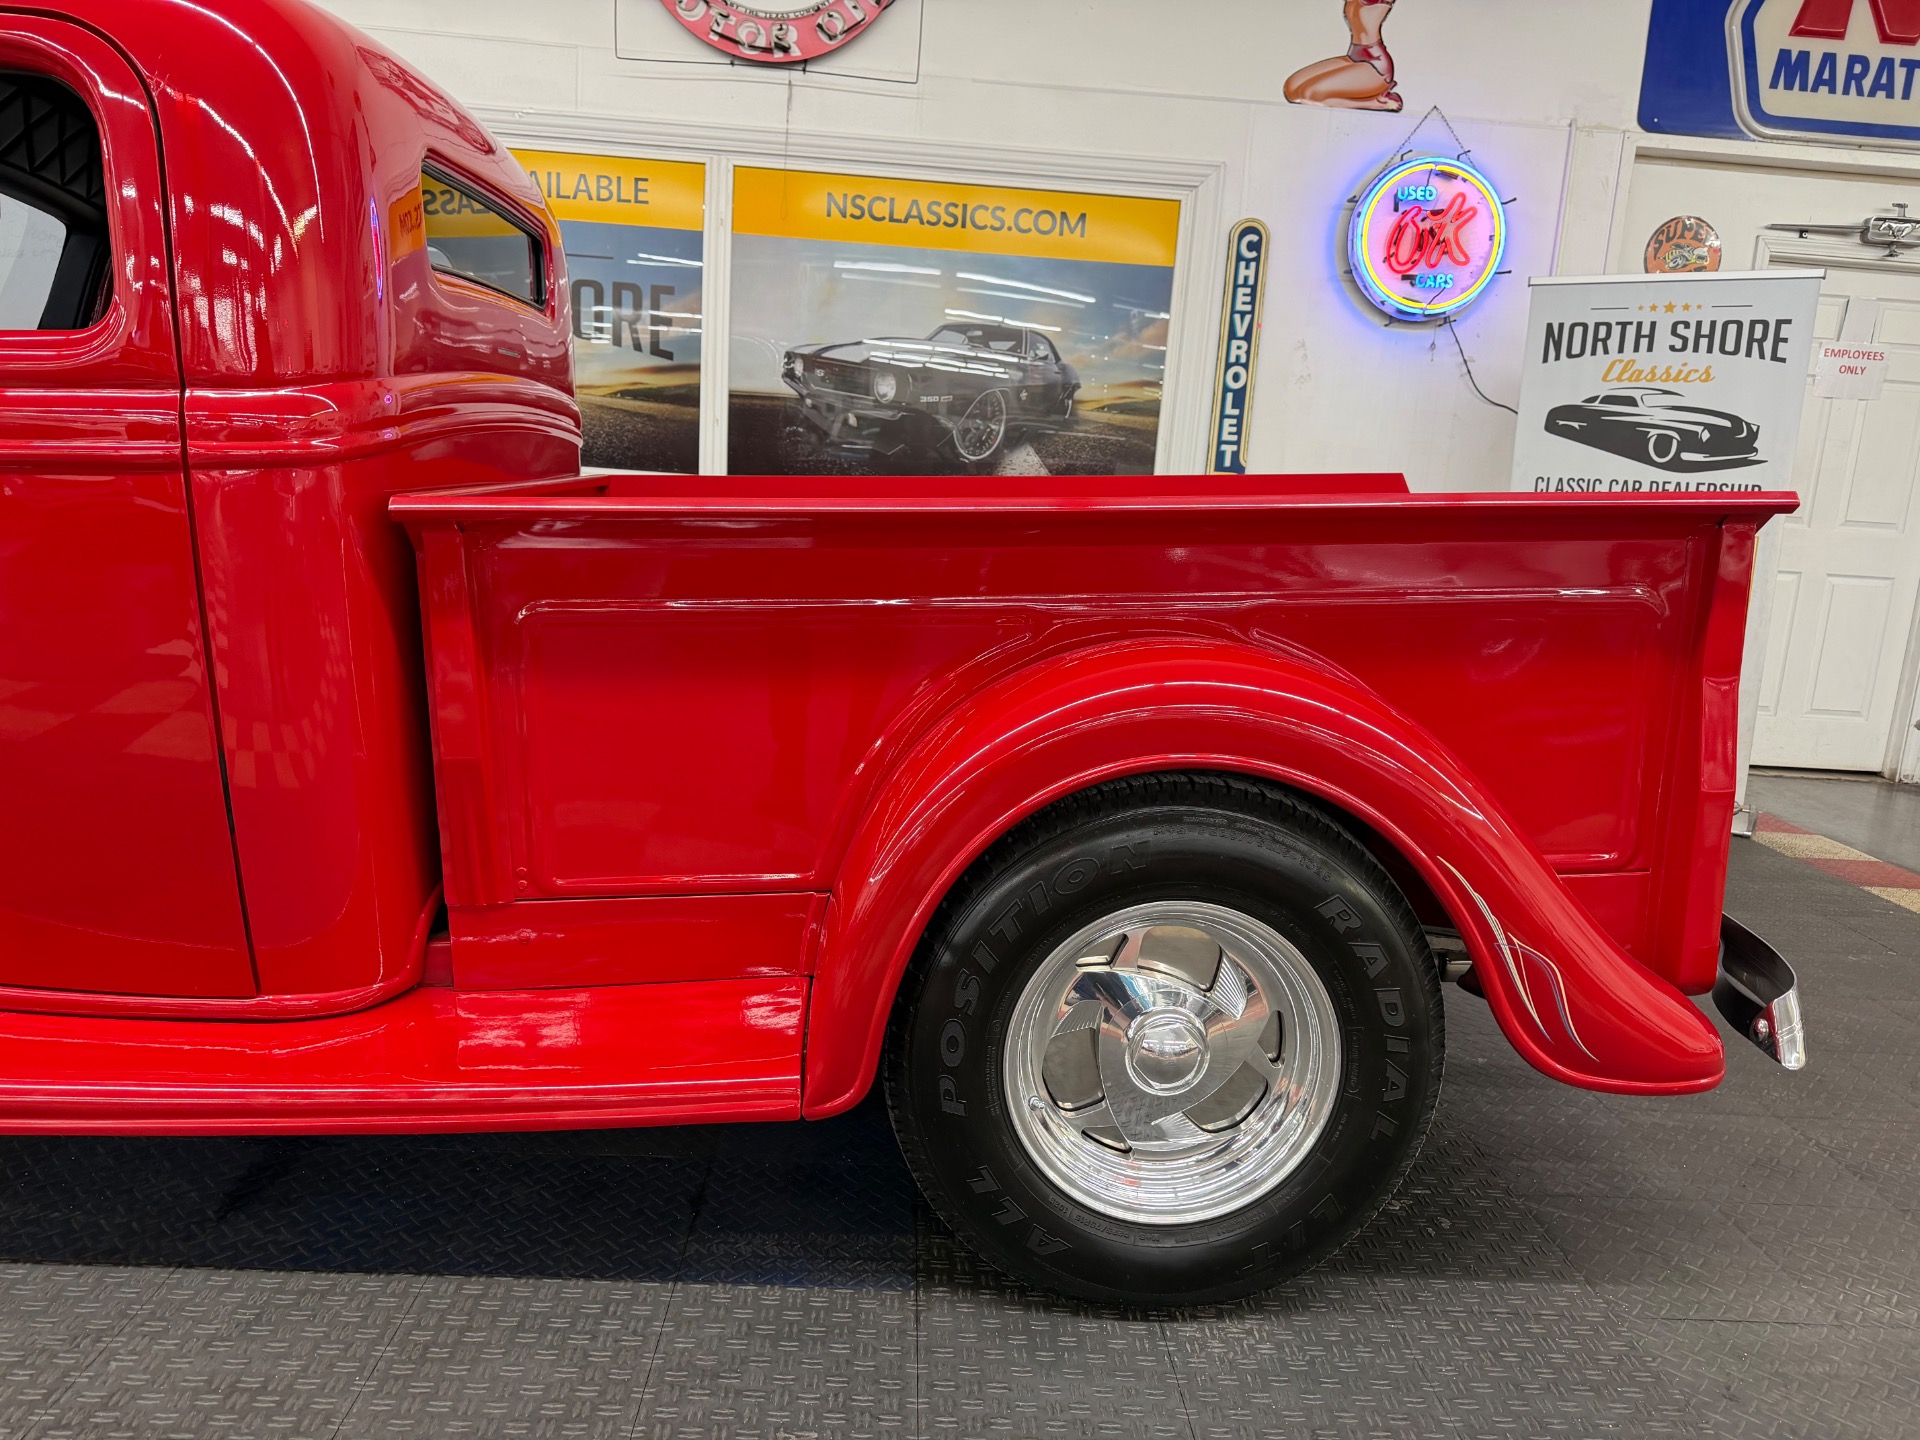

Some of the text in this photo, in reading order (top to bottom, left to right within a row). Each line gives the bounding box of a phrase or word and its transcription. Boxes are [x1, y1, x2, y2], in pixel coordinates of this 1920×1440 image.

[1769, 48, 1920, 100] MARAT
[826, 192, 1087, 238] NSCLASSICS.COM
[1397, 185, 1437, 201] USED
[1415, 273, 1454, 289] CARS
[1219, 233, 1260, 468] CHEVROLET
[1542, 319, 1793, 364] NORTH SHORE
[1823, 348, 1885, 361] EMPLOYEES
[1601, 358, 1716, 383] Classics
[1838, 365, 1867, 375] ONLY
[938, 840, 1152, 1117] POSITION
[1313, 894, 1410, 1141] RADIAL
[966, 1165, 1072, 1255] ALL
